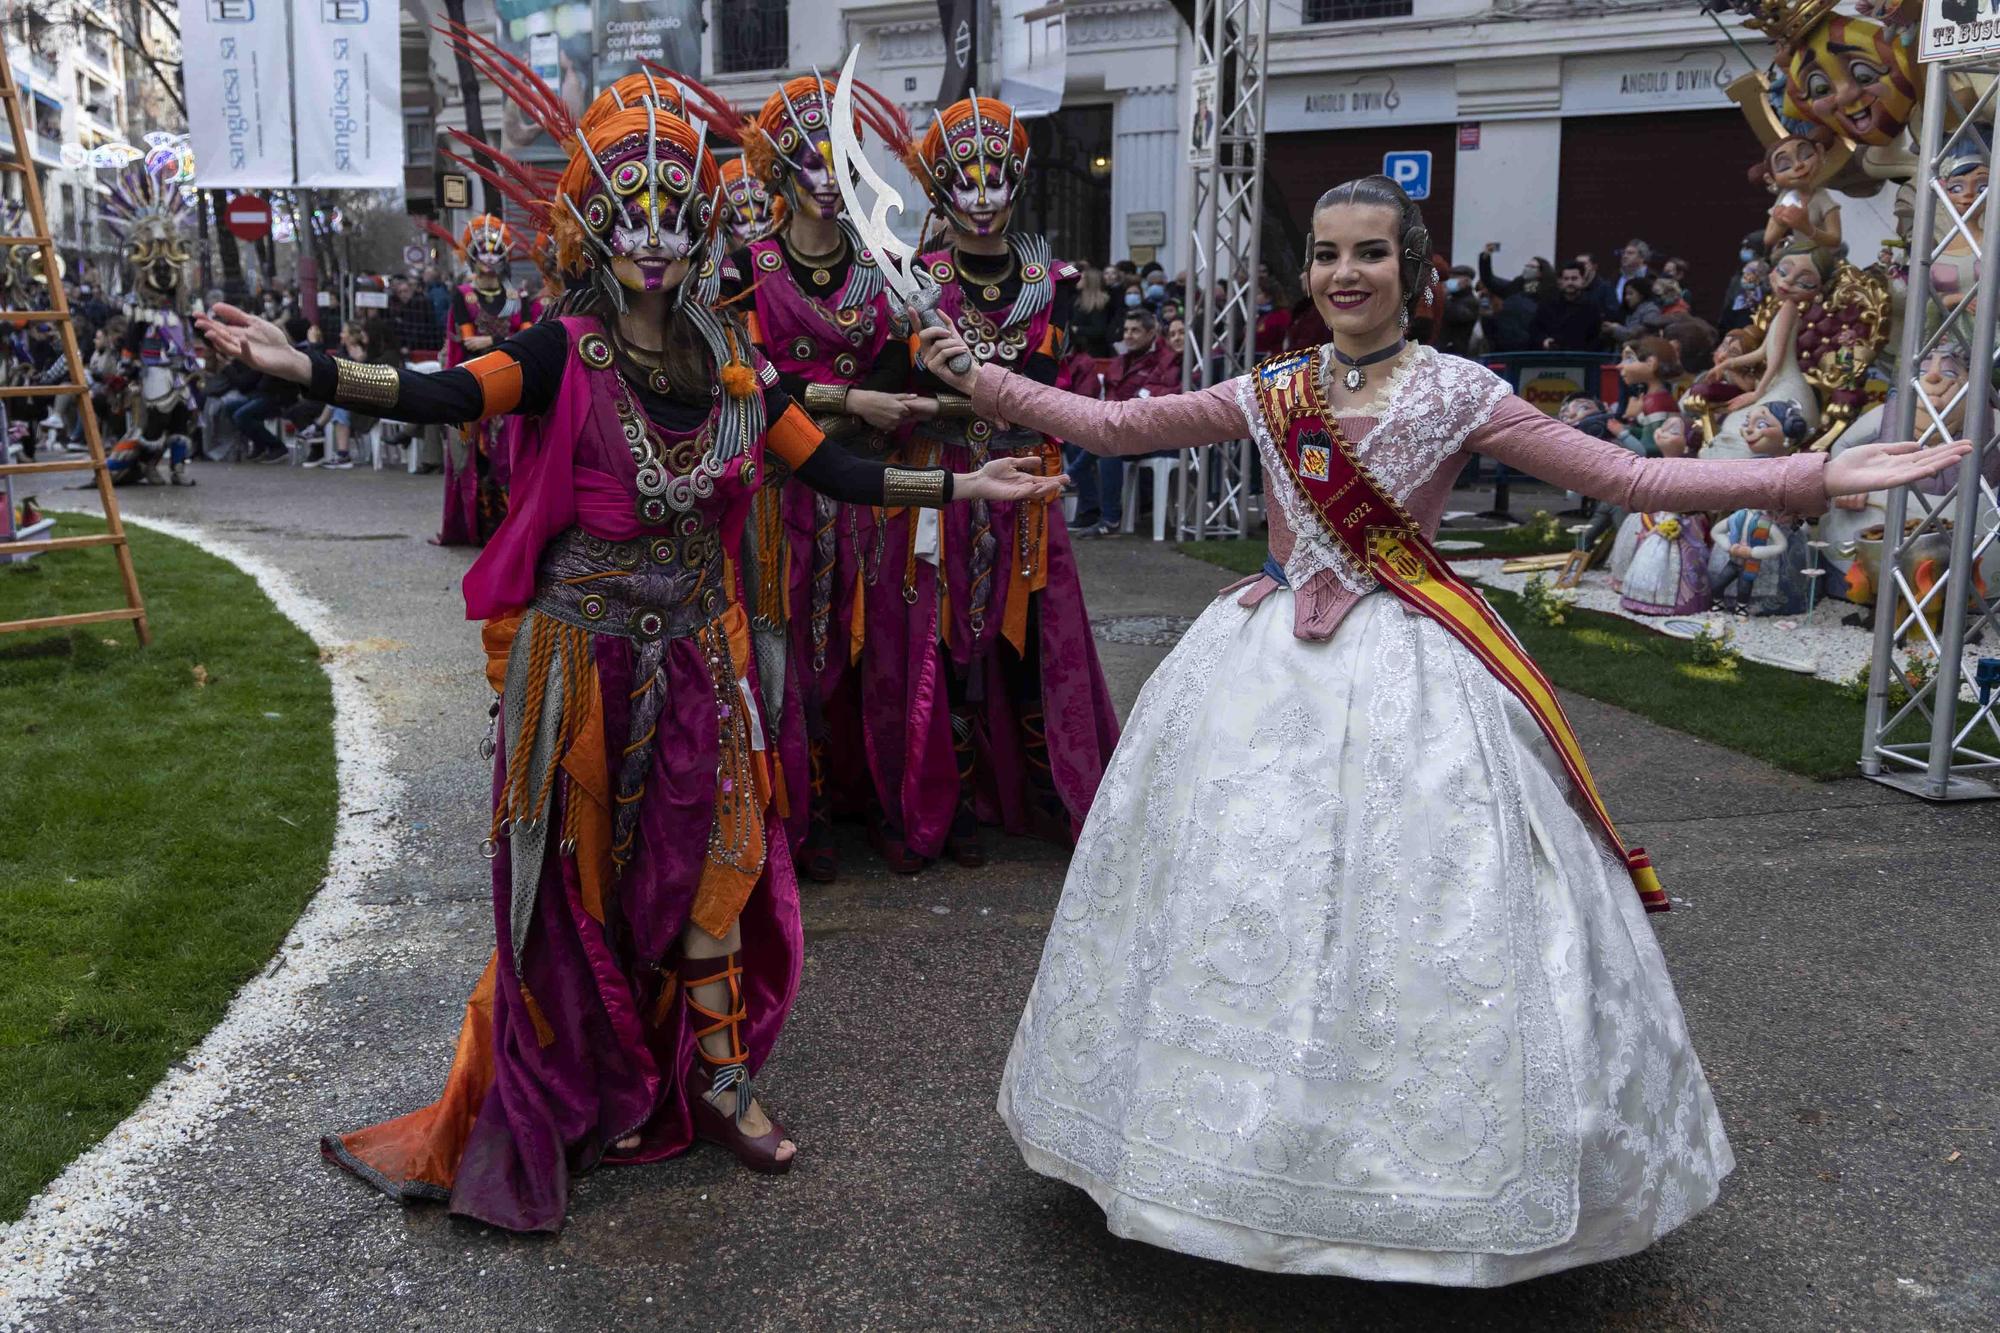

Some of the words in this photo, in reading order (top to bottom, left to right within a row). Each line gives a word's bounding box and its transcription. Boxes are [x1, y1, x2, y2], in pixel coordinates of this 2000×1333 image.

[607, 37, 627, 48] con
[1933, 25, 1955, 47] TE
[333, 38, 349, 60] sa
[607, 50, 622, 63] de
[1620, 72, 1668, 94] ANGOLO
[1305, 94, 1346, 113] ANGOLO
[329, 69, 358, 171] sangüesa
[1394, 159, 1420, 186] P
[1343, 502, 1373, 529] 2022
